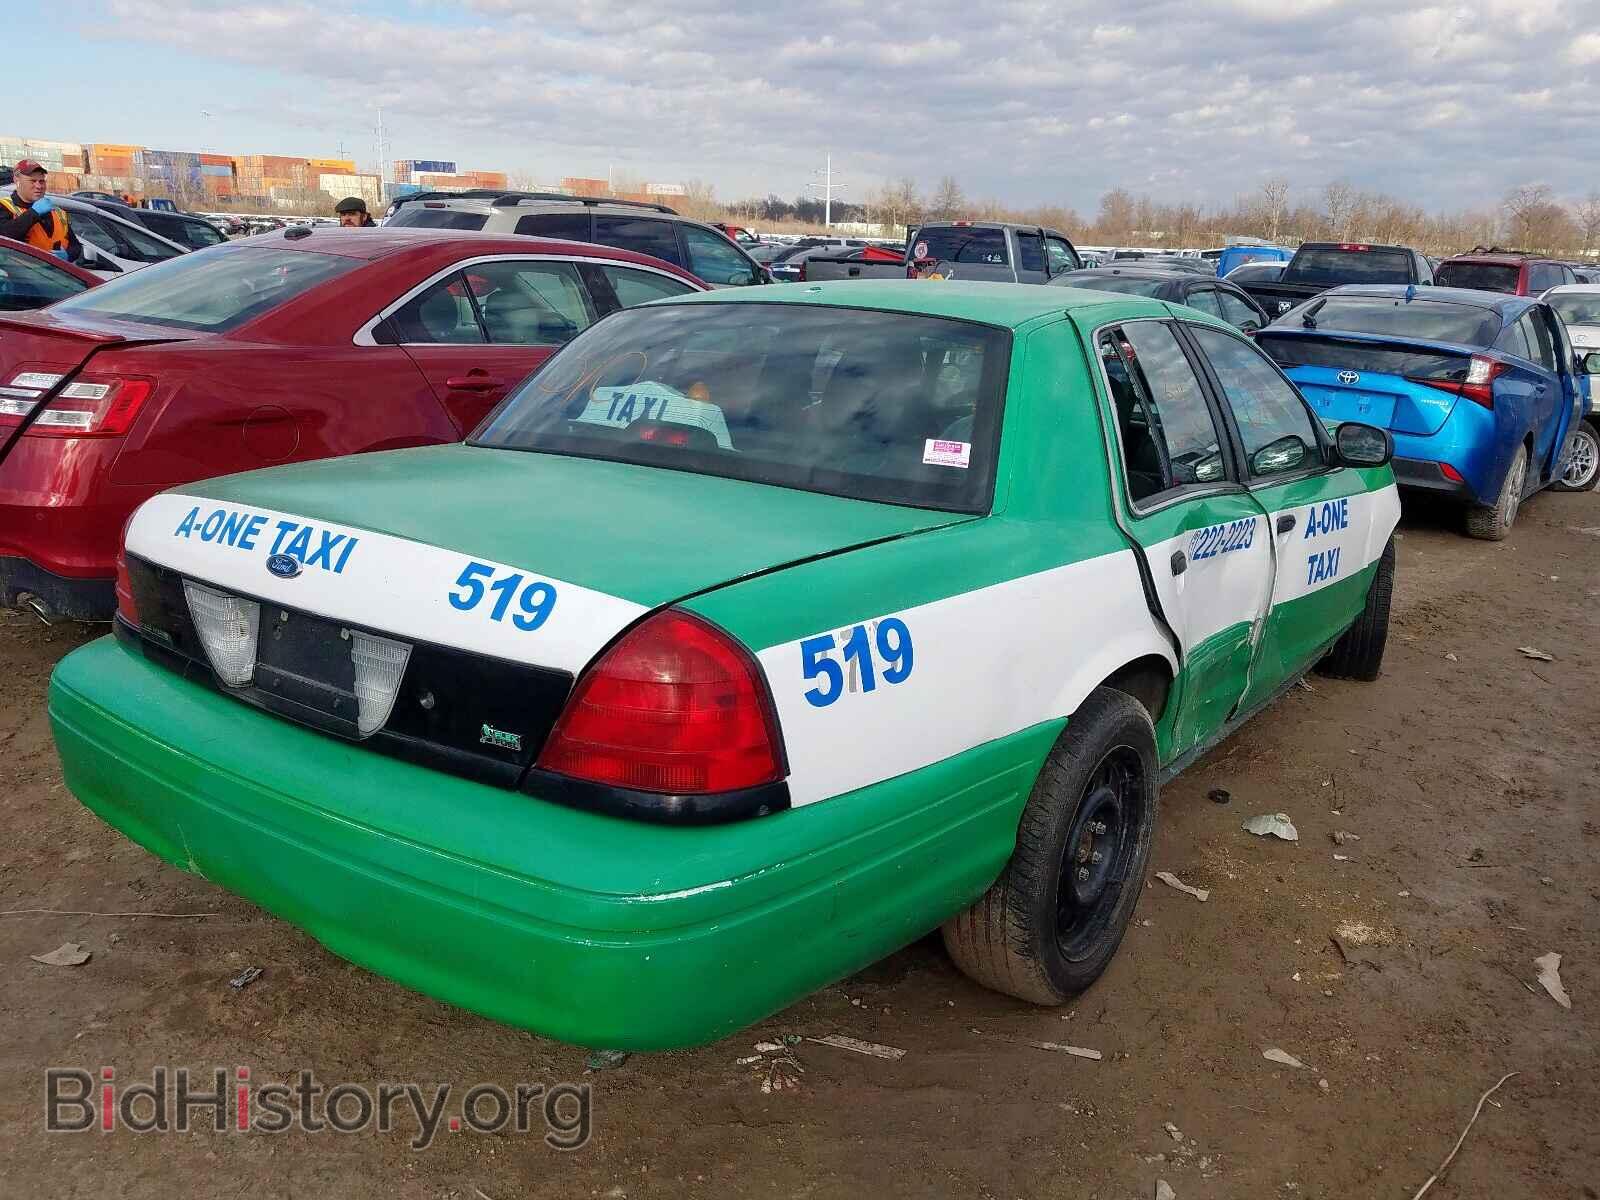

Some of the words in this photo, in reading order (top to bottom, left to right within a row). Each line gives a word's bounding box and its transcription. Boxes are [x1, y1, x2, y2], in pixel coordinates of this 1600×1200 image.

[606, 392, 669, 422] TAXI
[174, 506, 269, 551] A-ONE
[269, 520, 360, 574] TAXI
[1304, 498, 1348, 539] A-ONE
[1307, 546, 1341, 585] TAXI
[448, 561, 558, 631] 519
[799, 617, 914, 708] 519
